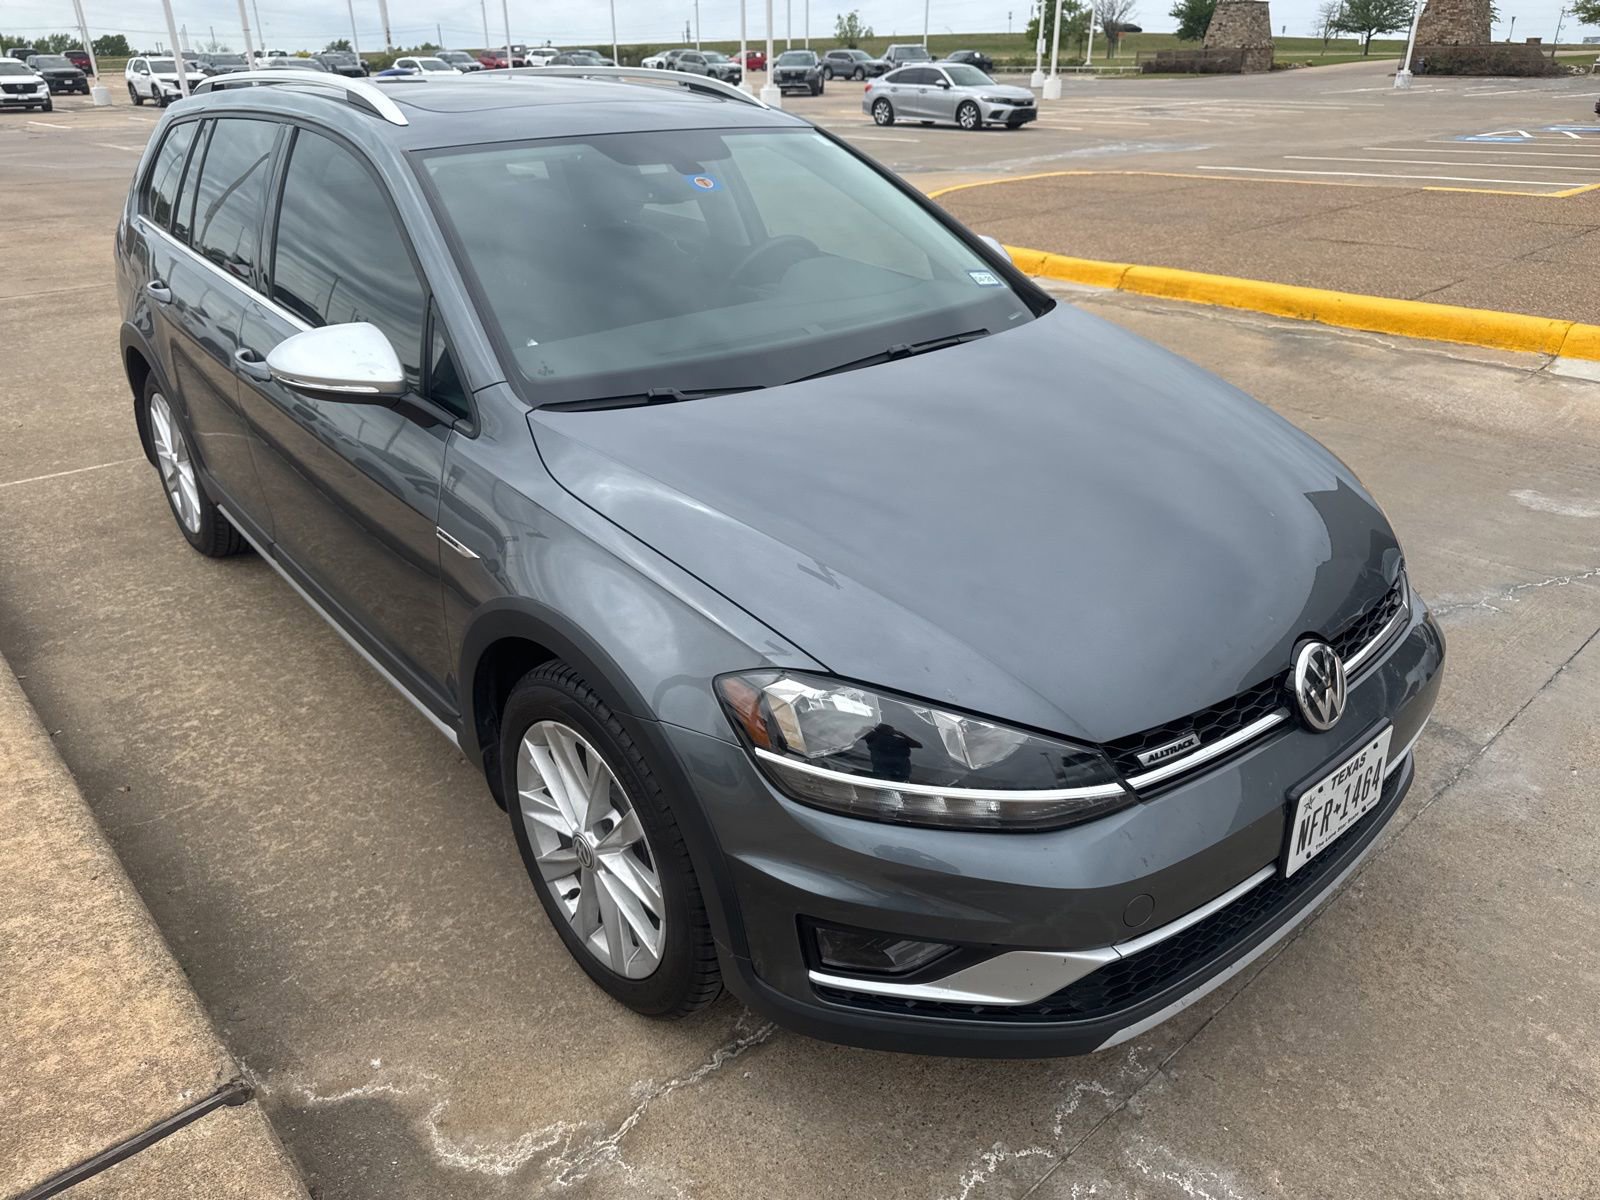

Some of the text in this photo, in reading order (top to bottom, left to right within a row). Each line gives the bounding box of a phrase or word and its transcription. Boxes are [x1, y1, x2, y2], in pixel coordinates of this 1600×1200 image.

[1147, 737, 1195, 763] ALLTRACK
[1331, 751, 1368, 791] TEXAS
[1296, 756, 1383, 856] NFR 1464
